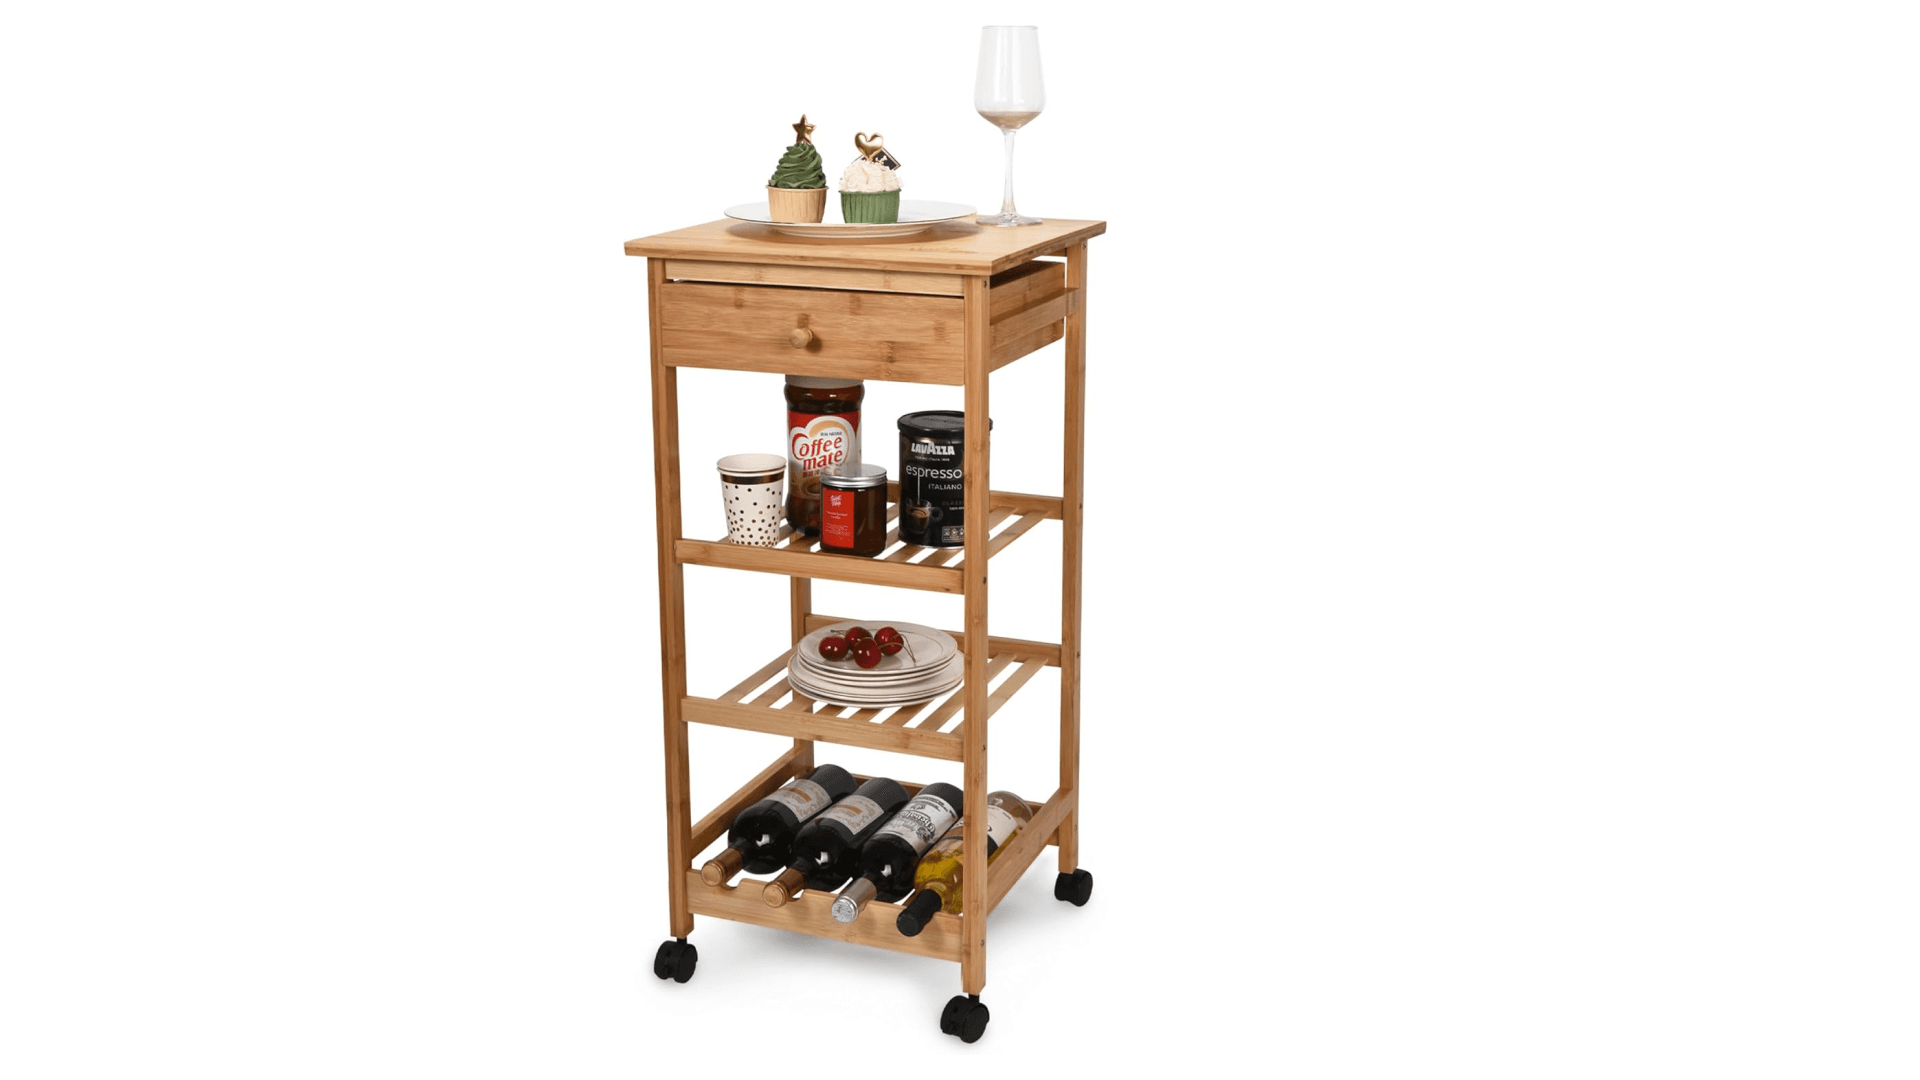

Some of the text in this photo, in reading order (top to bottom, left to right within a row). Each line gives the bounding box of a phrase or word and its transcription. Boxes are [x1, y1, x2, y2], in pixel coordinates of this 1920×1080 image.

[792, 432, 843, 461] Coffee
[910, 442, 956, 455] LAVAZZA
[803, 450, 843, 470] mate
[905, 465, 963, 479] espresso
